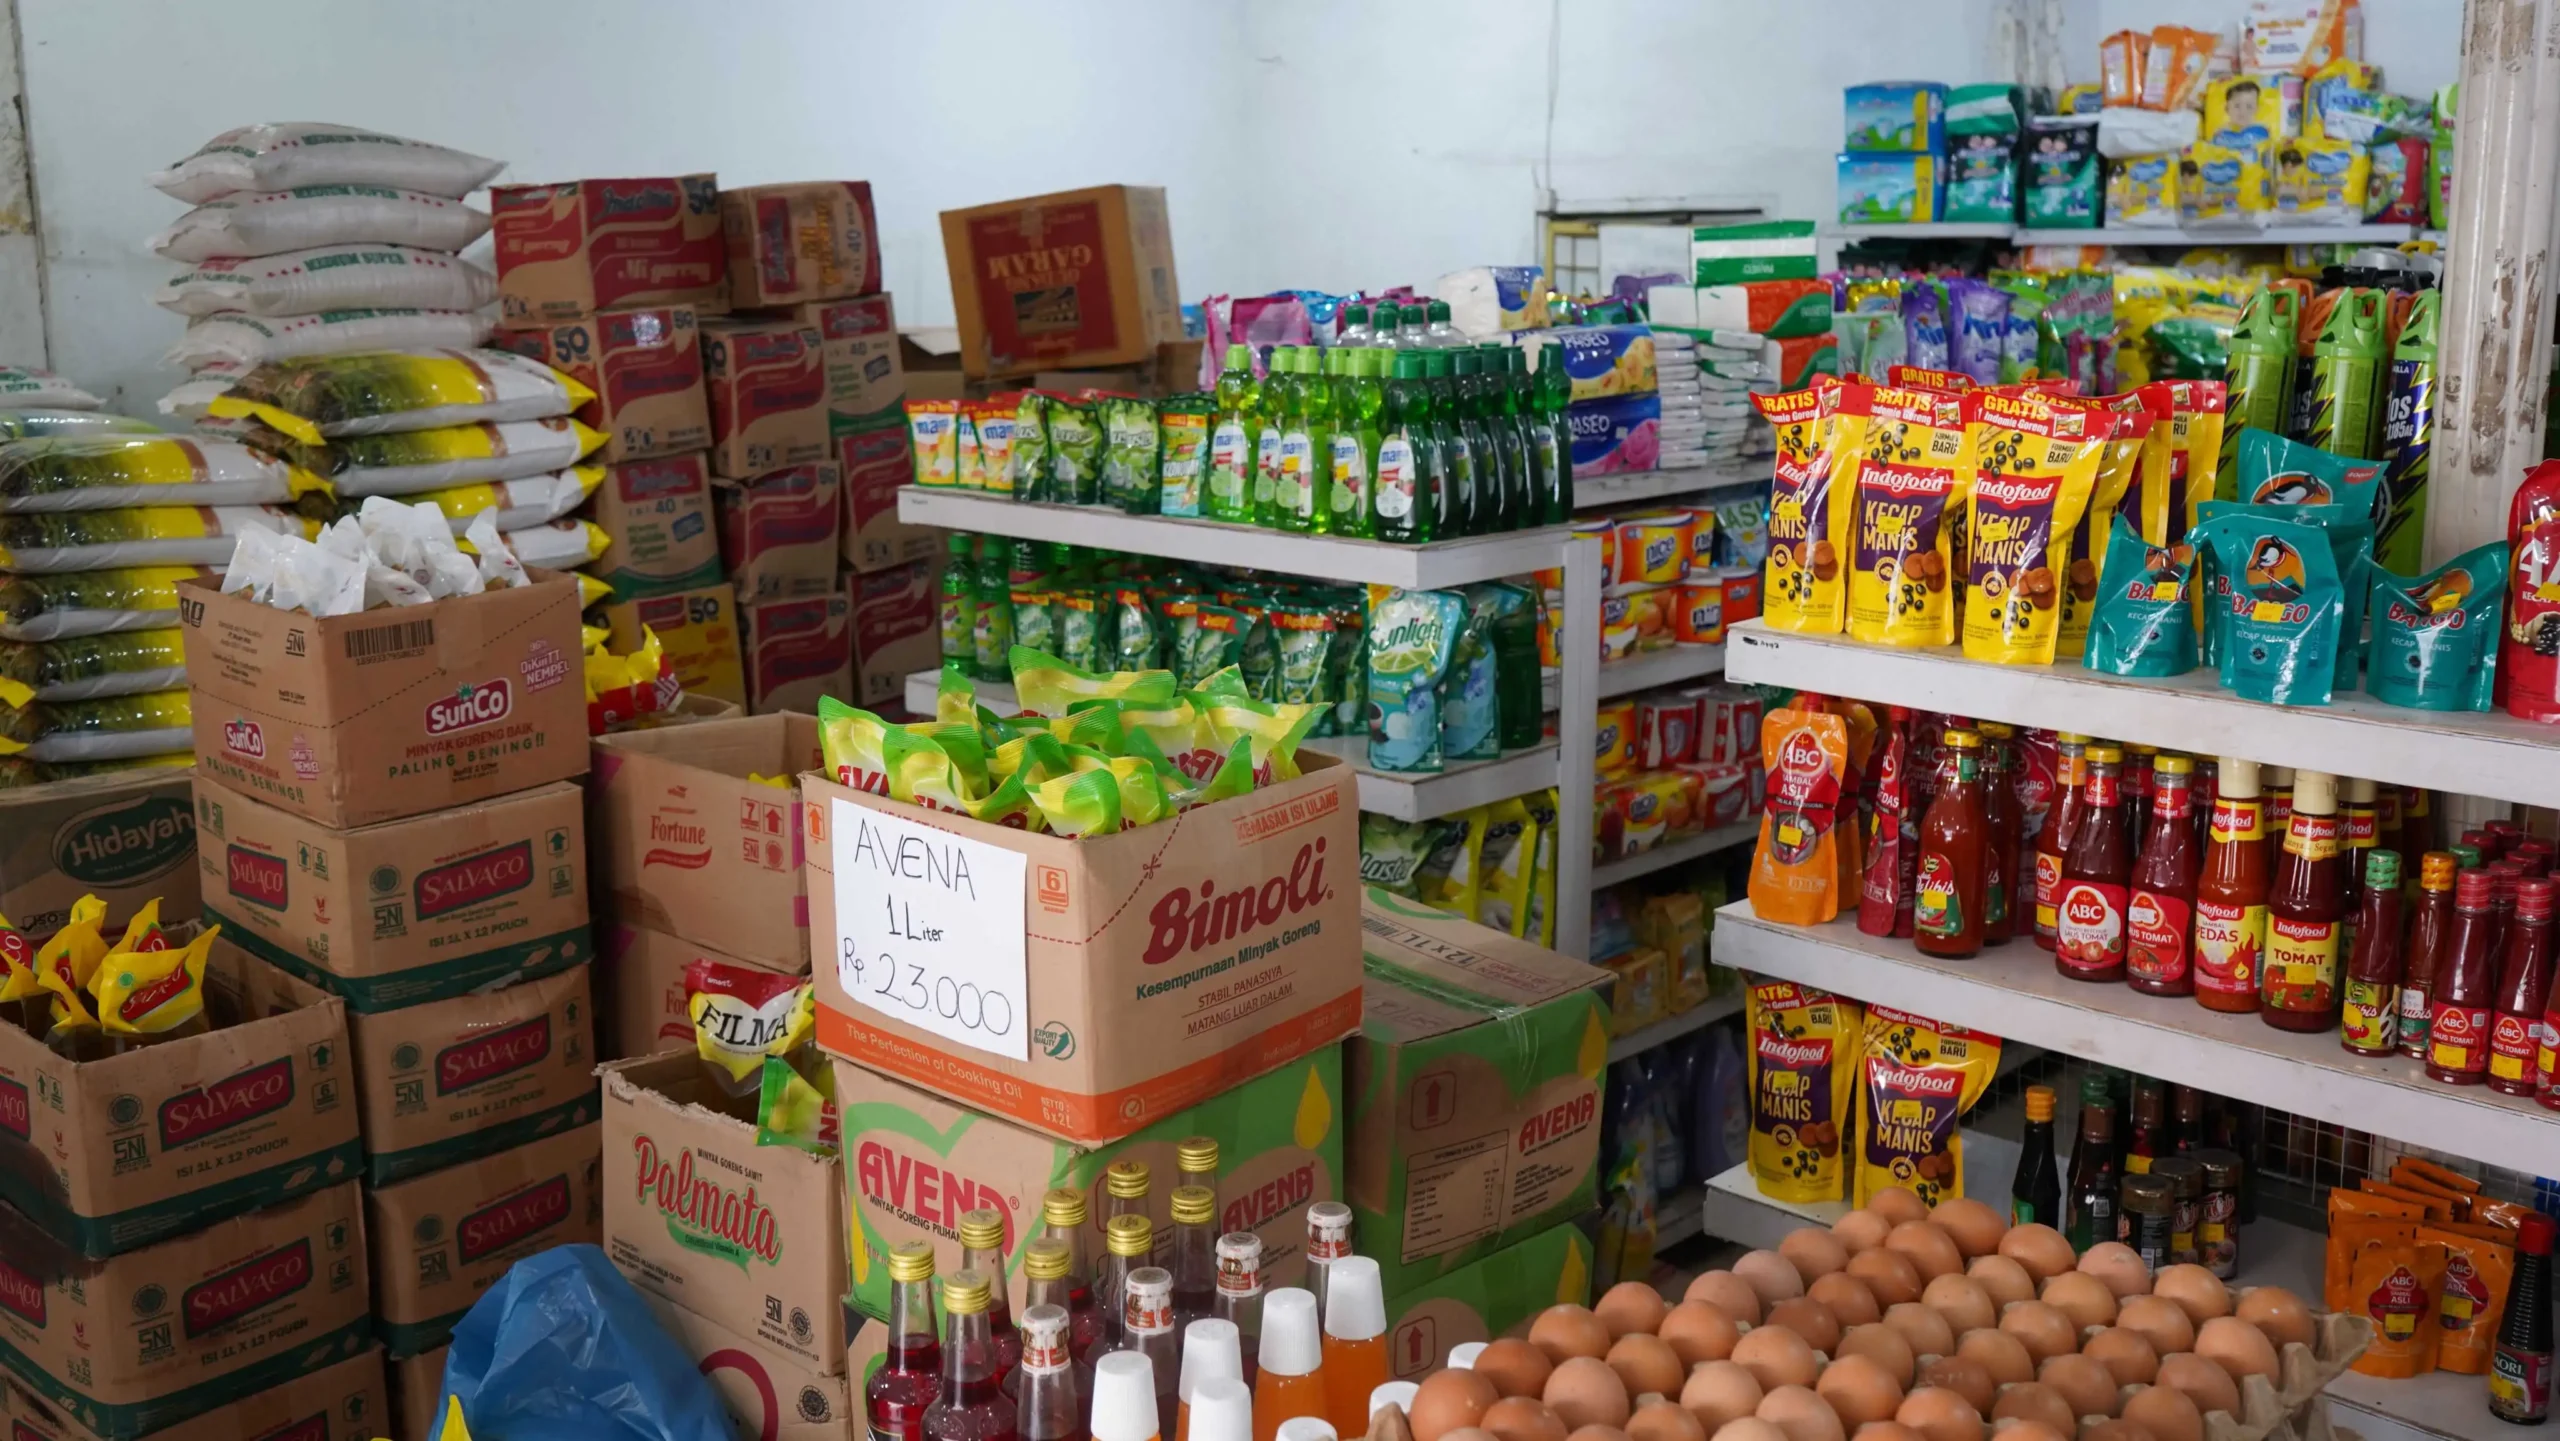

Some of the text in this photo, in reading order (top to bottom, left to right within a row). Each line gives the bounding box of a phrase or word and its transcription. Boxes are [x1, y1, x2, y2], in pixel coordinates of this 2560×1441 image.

[988, 245, 1092, 280] GARAM
[1902, 368, 1944, 386] GRATIS
[1984, 395, 2050, 420] GRATIS
[1984, 413, 2016, 428] Indomie
[2019, 420, 2048, 436] Goreng
[2047, 451, 2072, 463] BARU
[2052, 443, 2076, 453] FORMULA
[1861, 467, 1944, 492] Indofood
[1976, 477, 2054, 504] Indofood
[655, 499, 675, 514] 40
[1974, 539, 2027, 566] MANIS
[689, 597, 718, 623] 50
[526, 660, 570, 685] NEMPEL
[431, 689, 503, 731] SunCo
[226, 726, 261, 752] SunCo
[406, 739, 453, 759] MINYAK
[507, 722, 534, 738] BAIK
[389, 732, 545, 778] PALING BENING!!
[1784, 749, 1819, 767] ABC
[1781, 783, 1810, 799] ASLI
[746, 802, 755, 819] 7
[1290, 804, 1305, 821] ISI
[1307, 791, 1339, 815] ULANG
[71, 806, 194, 867] Hidayah
[651, 815, 705, 845] Fortune
[2294, 823, 2335, 837] Indofood
[855, 817, 975, 901] AVENA
[422, 856, 524, 904] SALVACO
[1046, 871, 1061, 889] 6
[2038, 869, 2054, 881] ABC
[1142, 835, 1328, 965] Bimoli
[2070, 903, 2101, 919] ABC
[464, 932, 472, 940] X
[475, 927, 488, 937] 12
[491, 917, 528, 934] POUCH
[886, 894, 945, 942] 1 Liter
[2277, 921, 2327, 937] Indofood
[1403, 934, 1476, 965] 12 X 1L
[2082, 933, 2108, 941] TOMAT
[2142, 932, 2173, 943] TOMAT
[1136, 919, 1321, 1000] Kesempurnaan Minyak Goreng
[2274, 948, 2325, 966] TOMAT
[875, 952, 1012, 1036] 23.000
[1198, 965, 1283, 1009] STABIL PANASNYA
[1757, 984, 1793, 1001] ATIS
[1187, 982, 1293, 1036] MATANG LUAR DALAM
[1811, 1013, 1832, 1026] BARU
[1877, 1007, 1935, 1031] Indomie Goreng
[696, 1000, 789, 1047] FILMA
[1034, 1028, 1058, 1040] EXPORT
[2443, 1018, 2464, 1028] ABC
[2500, 1027, 2519, 1038] ABC
[1033, 1036, 1055, 1048] QUALITY
[1758, 1037, 1825, 1064] Indofood
[1940, 1044, 1967, 1058] BARU
[2450, 1035, 2474, 1044] TOMAT
[2505, 1046, 2530, 1055] TOMAT
[444, 1030, 543, 1081] SALVACO
[846, 1024, 1022, 1099] The Perfection of Cooking Oil
[1874, 1066, 1956, 1092] Indofood
[168, 1074, 284, 1134] SALVACO
[483, 1104, 490, 1114] X
[1761, 1093, 1811, 1122] MANIS
[1519, 1092, 1596, 1152] AVENA
[113, 1137, 145, 1163] SNI
[215, 1155, 225, 1167] X
[228, 1151, 243, 1164] 12
[247, 1137, 289, 1159] POUCH
[1877, 1125, 1933, 1154] MANIS
[720, 1157, 742, 1175] GORENG
[745, 1166, 763, 1183] SAWIT
[635, 1136, 779, 1260] Palmata
[859, 1140, 1015, 1258] AVENA
[1223, 1166, 1314, 1234] AVENA
[465, 1190, 562, 1248] SALVACO
[869, 1193, 895, 1216] MINYAK
[897, 1204, 930, 1231] GORENG
[2390, 1275, 2413, 1286] ABC
[2448, 1263, 2472, 1275] ABC
[193, 1256, 302, 1322] SALVACO
[2391, 1295, 2411, 1304] ASLI
[139, 1327, 172, 1352] SNI
[239, 1341, 247, 1354] X
